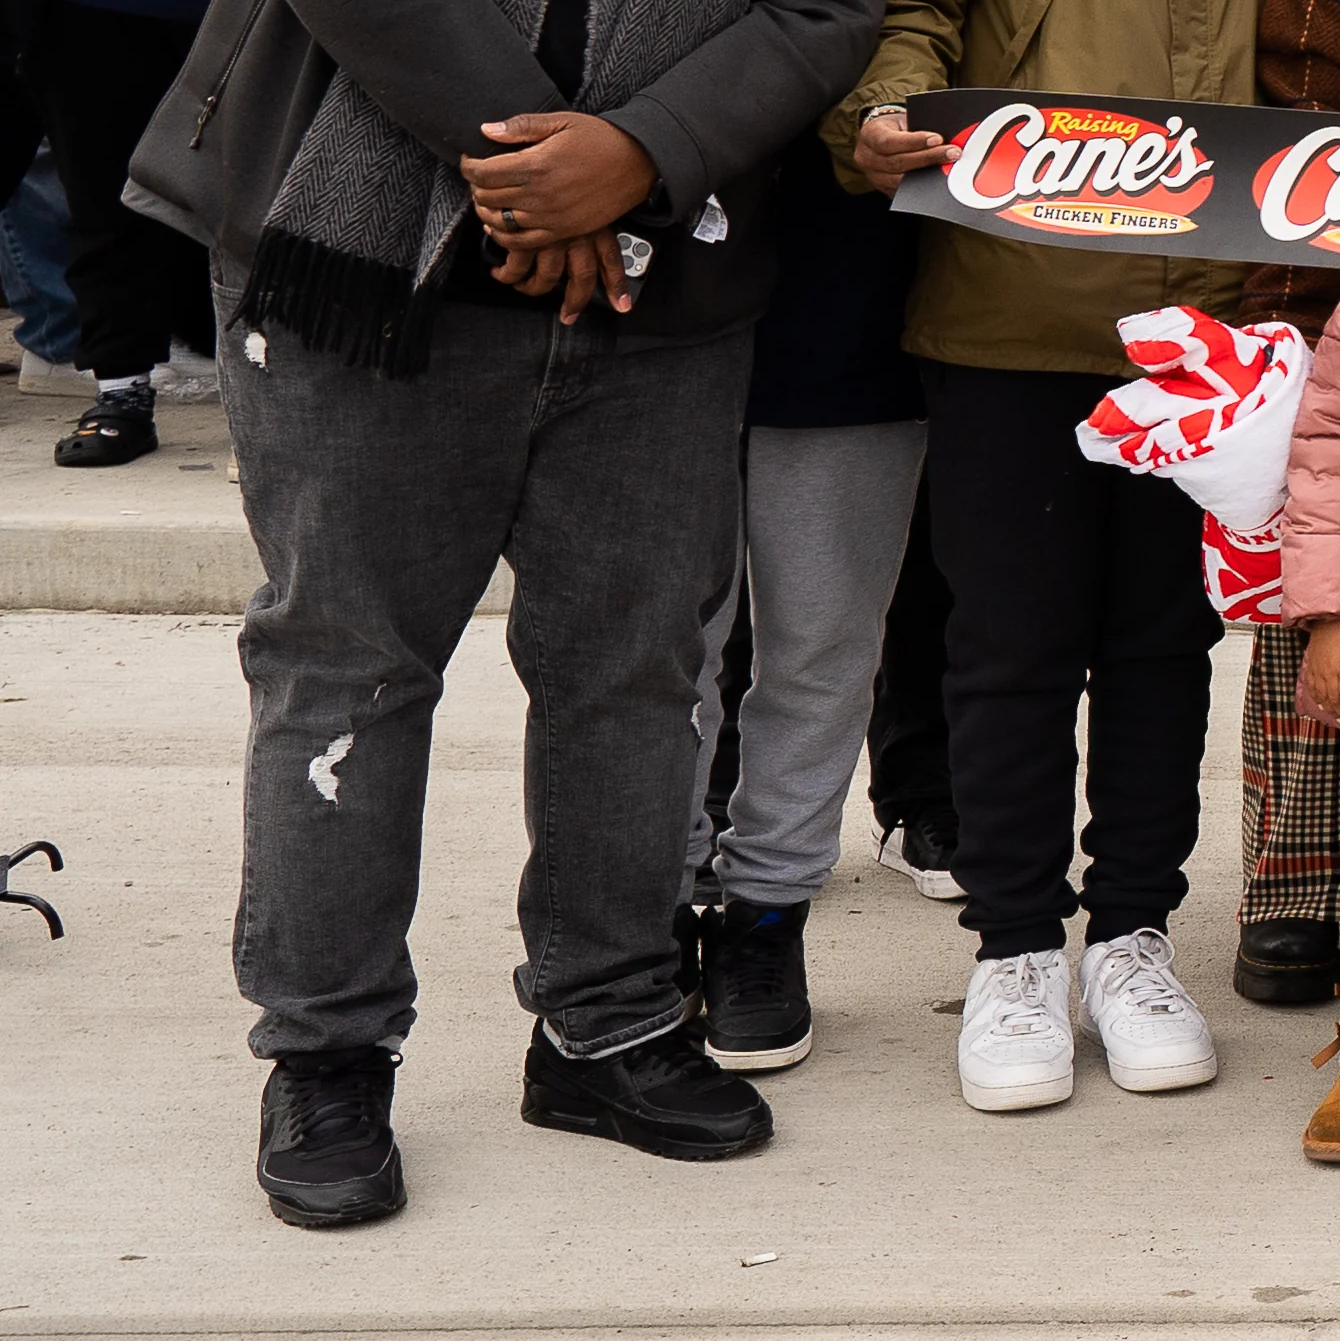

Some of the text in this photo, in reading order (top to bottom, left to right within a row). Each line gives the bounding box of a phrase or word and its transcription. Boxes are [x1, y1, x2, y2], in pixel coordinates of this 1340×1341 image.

[1048, 112, 1140, 141] Raising
[947, 103, 1214, 209] Cane's
[1033, 205, 1178, 230] CHICKEN FINGERS
